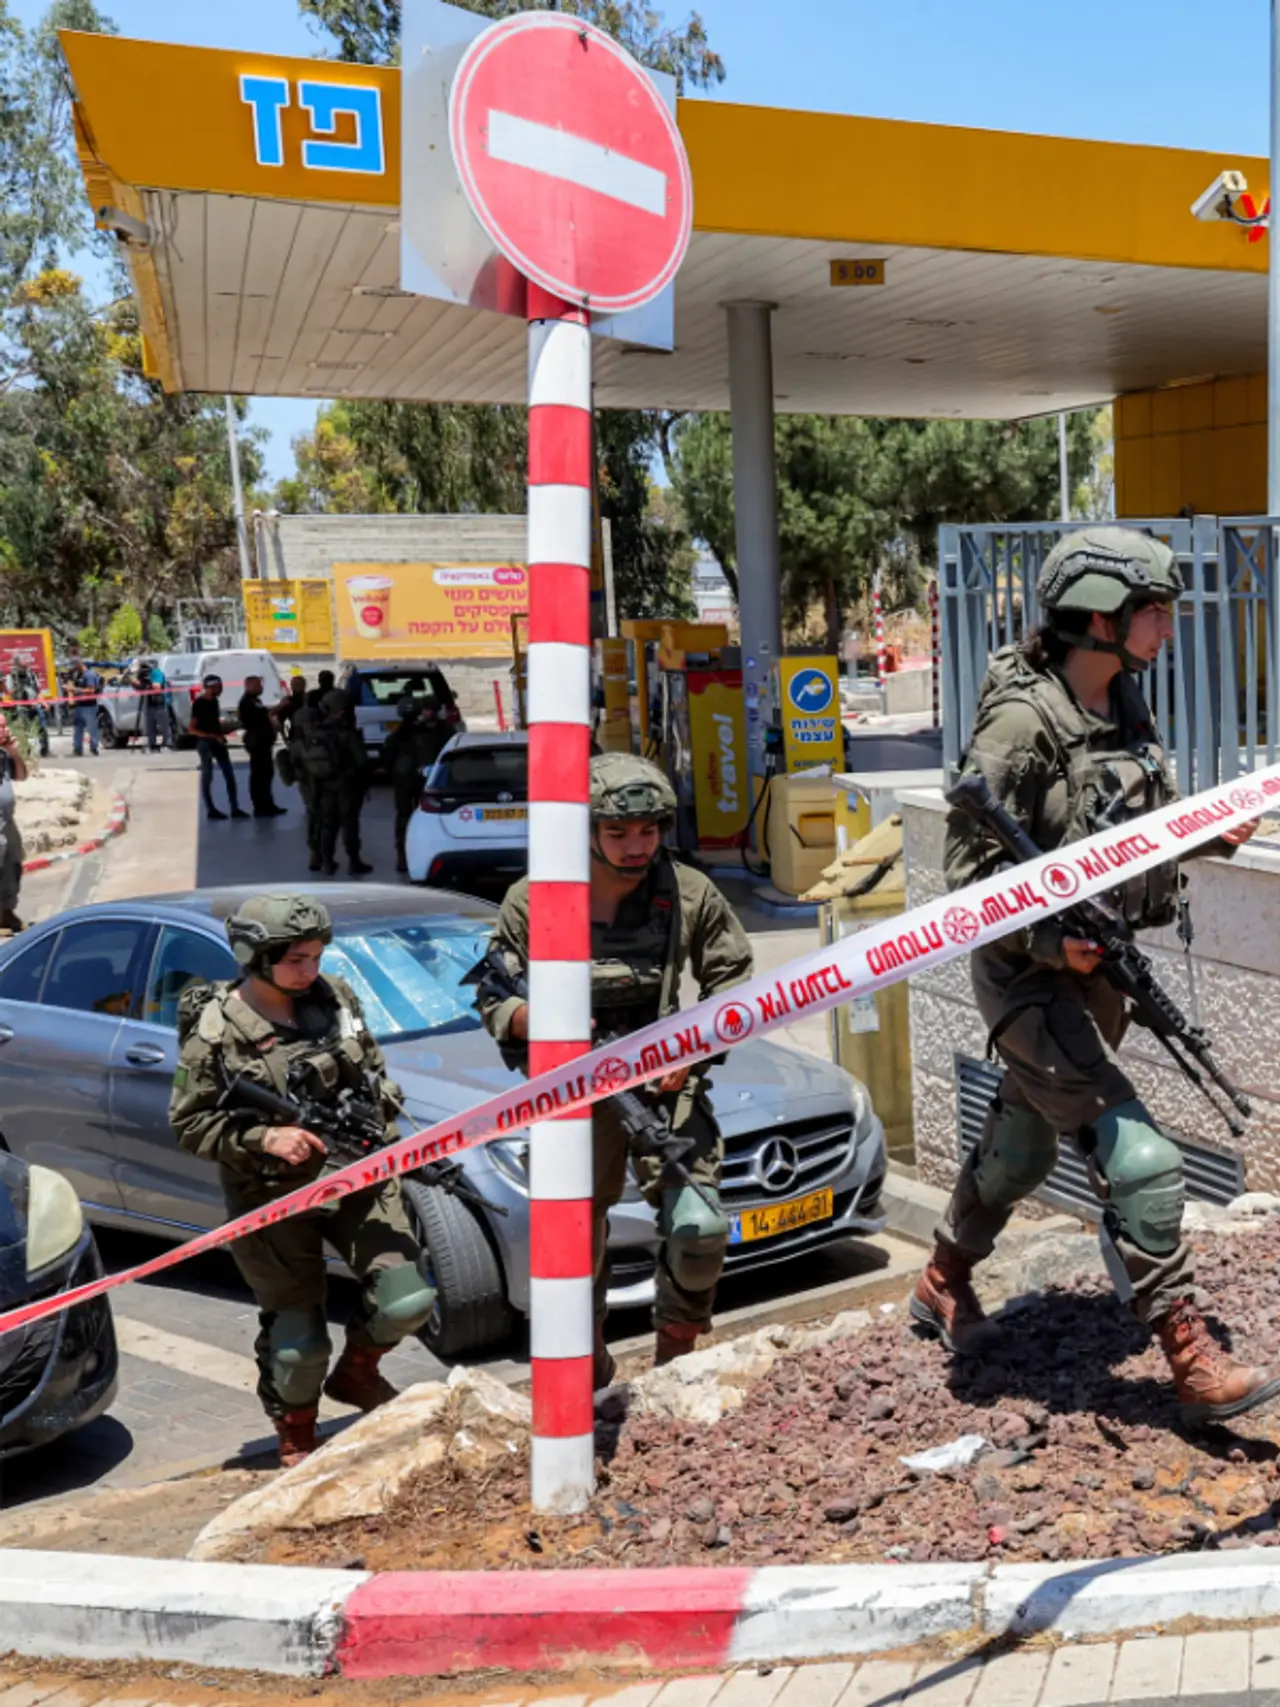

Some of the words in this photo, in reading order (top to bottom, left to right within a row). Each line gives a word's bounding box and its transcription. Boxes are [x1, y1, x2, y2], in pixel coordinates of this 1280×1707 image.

[239, 74, 385, 175] פז
[712, 713, 738, 814] travel
[1075, 847, 1109, 881] אין
[1105, 833, 1160, 868] מעבר
[865, 920, 945, 976] משטרת
[980, 881, 1049, 927] ישראל
[756, 981, 789, 1023] אין
[789, 963, 852, 1010] מעבר
[496, 1074, 586, 1132] משטרת
[634, 1024, 711, 1076] ישראל
